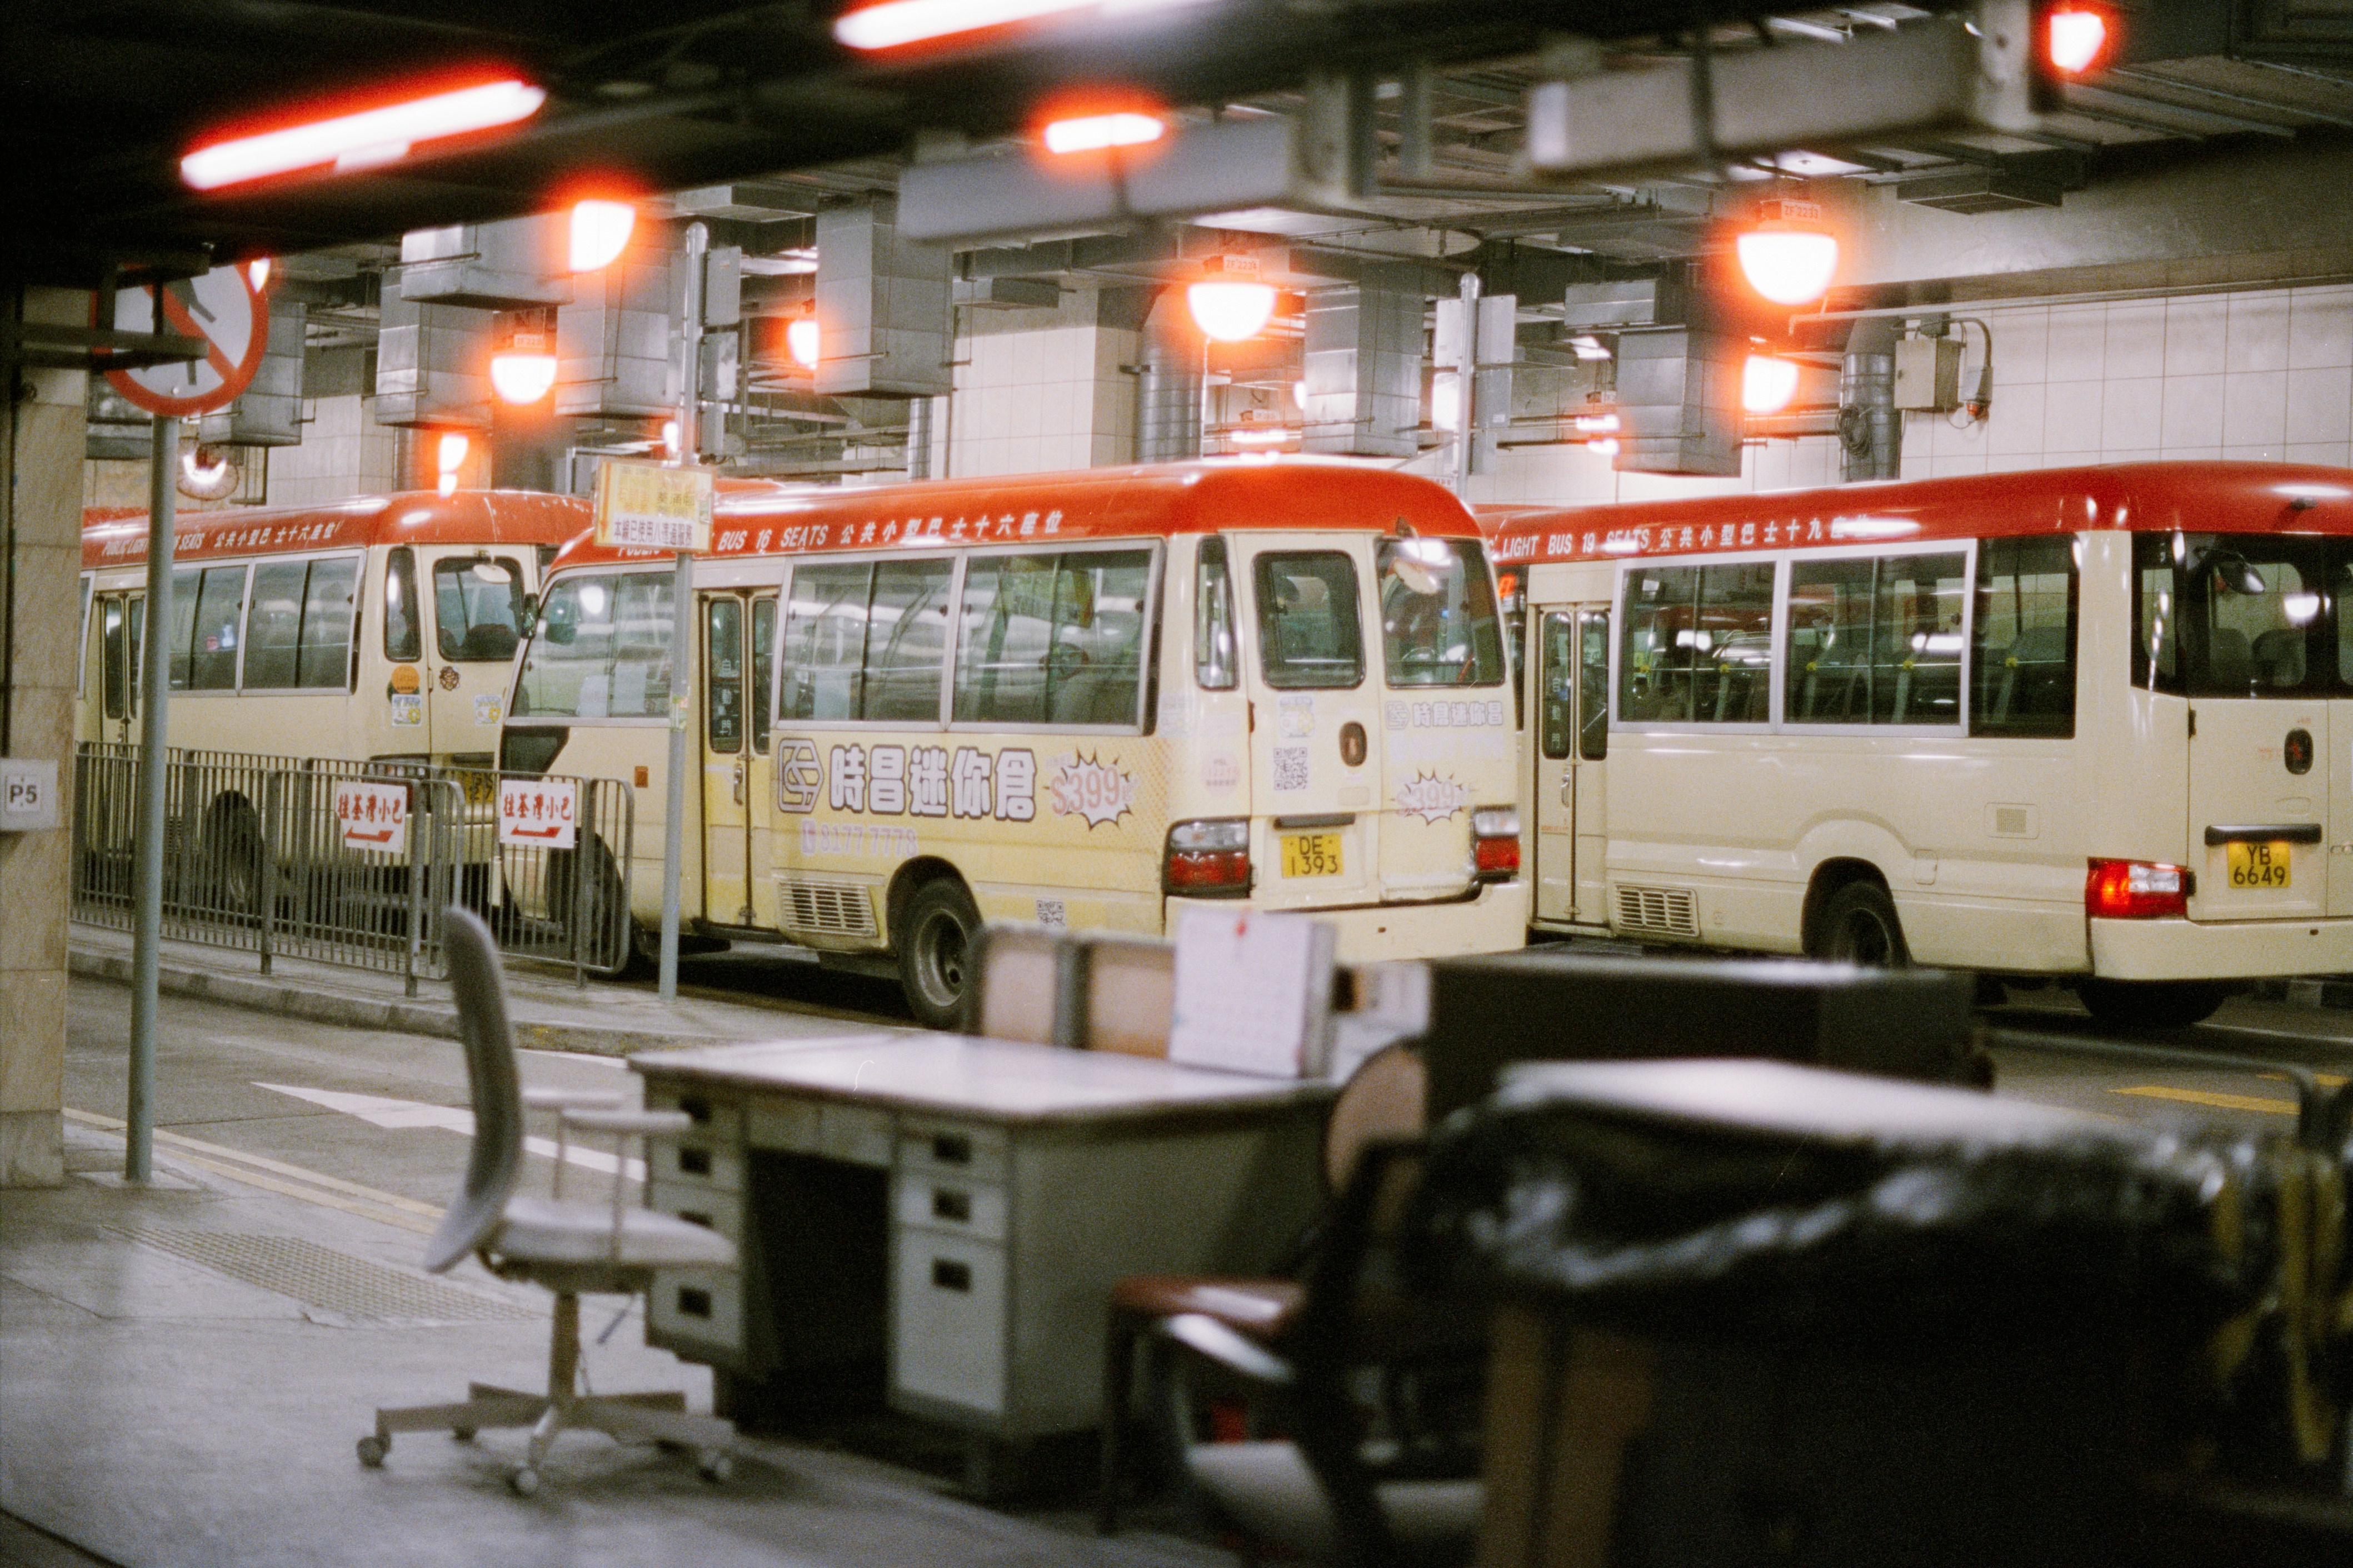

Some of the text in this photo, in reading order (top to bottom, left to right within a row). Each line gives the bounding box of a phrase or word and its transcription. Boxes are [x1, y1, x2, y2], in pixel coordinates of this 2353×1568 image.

[179, 533, 205, 550] SEATS
[718, 525, 828, 550] BUS 16 SEATS
[1502, 535, 1538, 558] LIGHT
[1547, 534, 1572, 555] BUS
[1582, 533, 1595, 553] 19
[829, 743, 1037, 822] 時昌迷你倉
[1051, 767, 1120, 815] $399
[10, 784, 37, 804] P5
[1298, 836, 1323, 855] DE
[2247, 845, 2271, 865] YB
[1290, 855, 1338, 876] 1393
[2233, 865, 2285, 885] 6649
